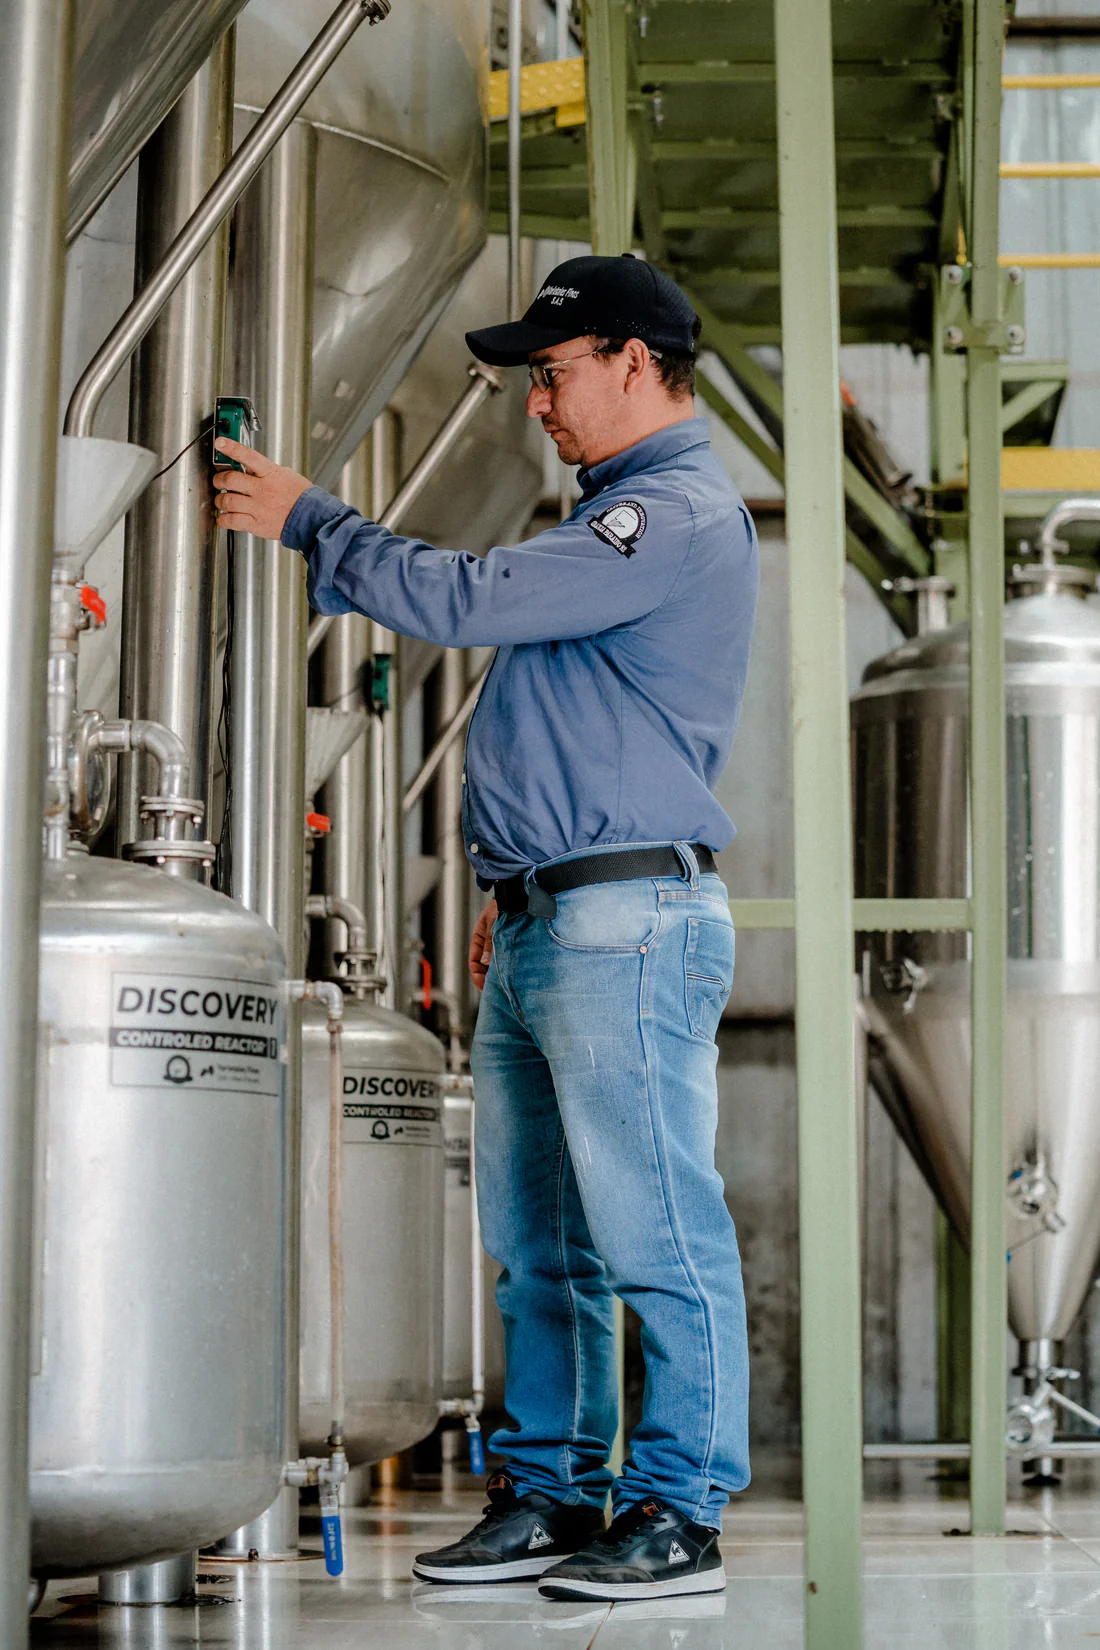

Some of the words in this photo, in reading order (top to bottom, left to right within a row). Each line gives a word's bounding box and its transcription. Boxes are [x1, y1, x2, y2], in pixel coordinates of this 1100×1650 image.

[117, 987, 277, 1025] DISCOVERY
[116, 1030, 213, 1050] CONTROLED
[214, 1035, 267, 1054] REACTOR
